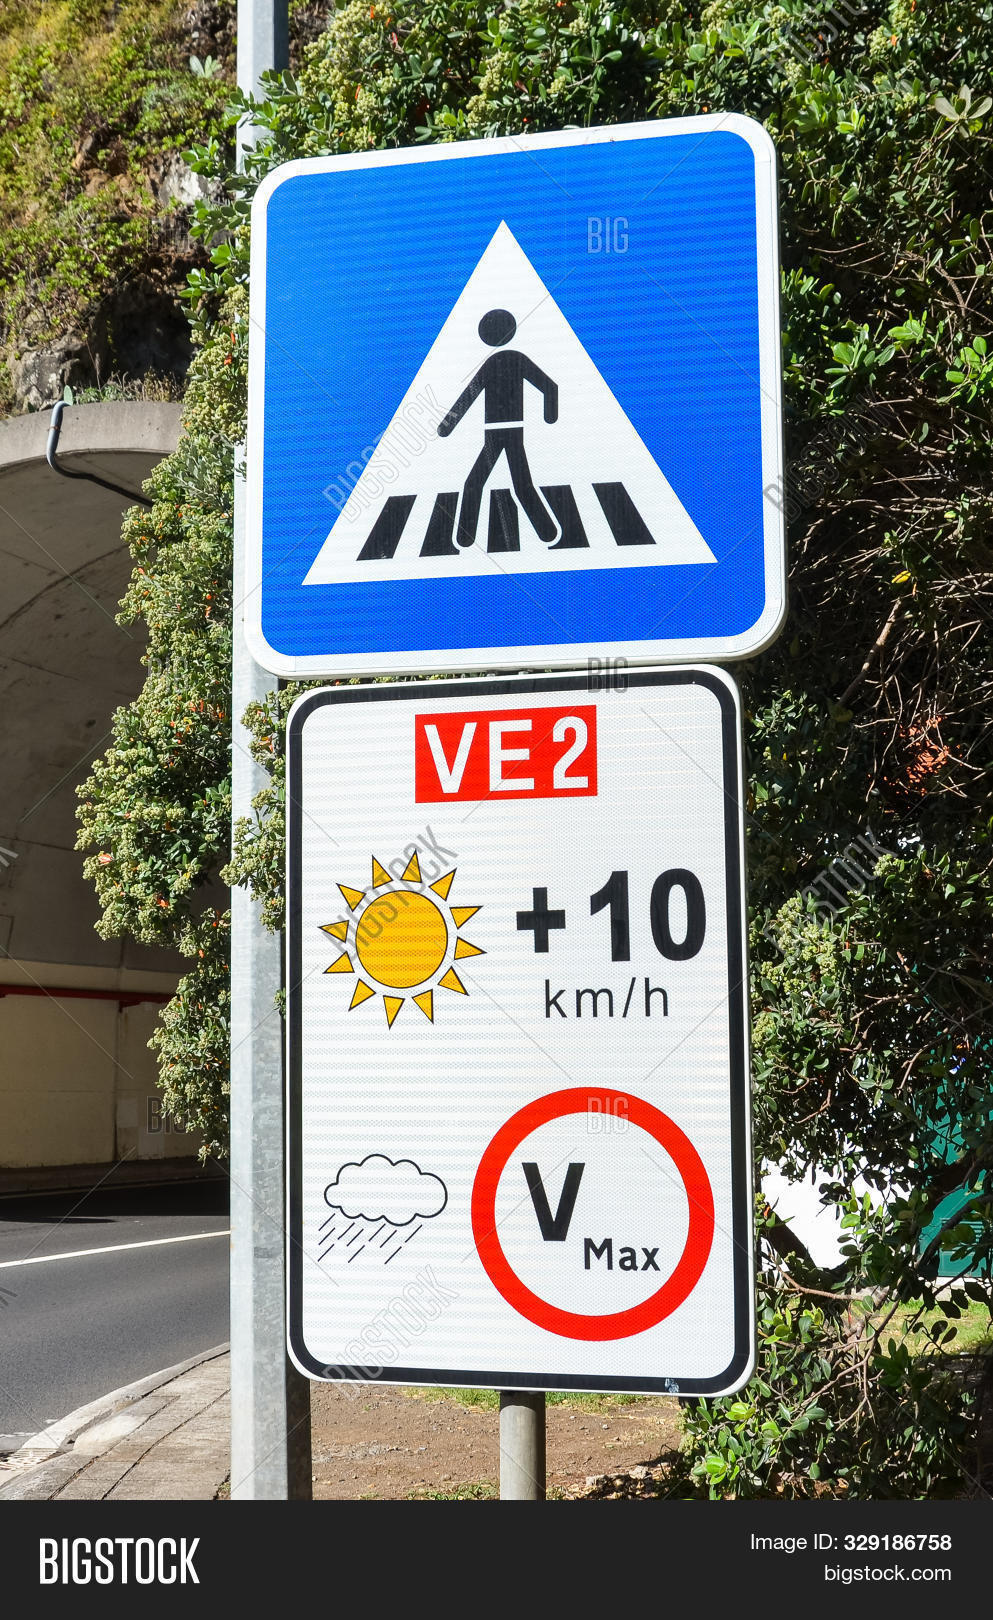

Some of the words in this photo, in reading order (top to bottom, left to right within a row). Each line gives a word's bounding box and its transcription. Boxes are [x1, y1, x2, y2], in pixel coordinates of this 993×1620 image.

[545, 977, 668, 1018] km/h
[521, 1162, 585, 1242] V
[584, 1237, 661, 1271] Max
